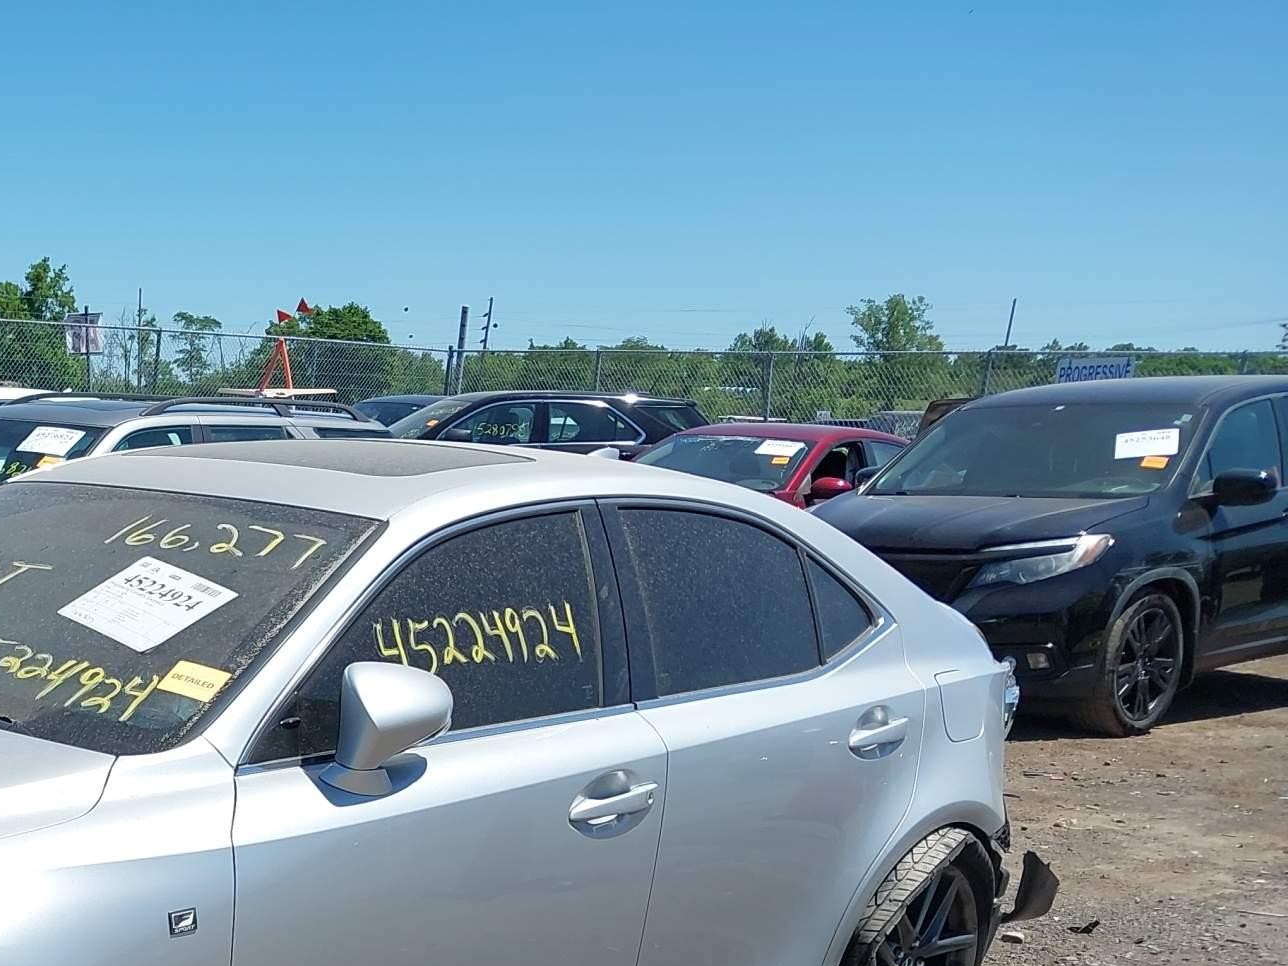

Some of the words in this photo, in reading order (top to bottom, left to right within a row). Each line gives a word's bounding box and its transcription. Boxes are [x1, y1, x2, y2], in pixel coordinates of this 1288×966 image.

[1058, 363, 1132, 384] PROGRESSIVE
[104, 513, 328, 570] 166,277
[123, 574, 205, 612] 45224924
[373, 599, 584, 675] 45224924
[171, 672, 215, 690] DETAILED
[173, 924, 196, 934] SPORT
